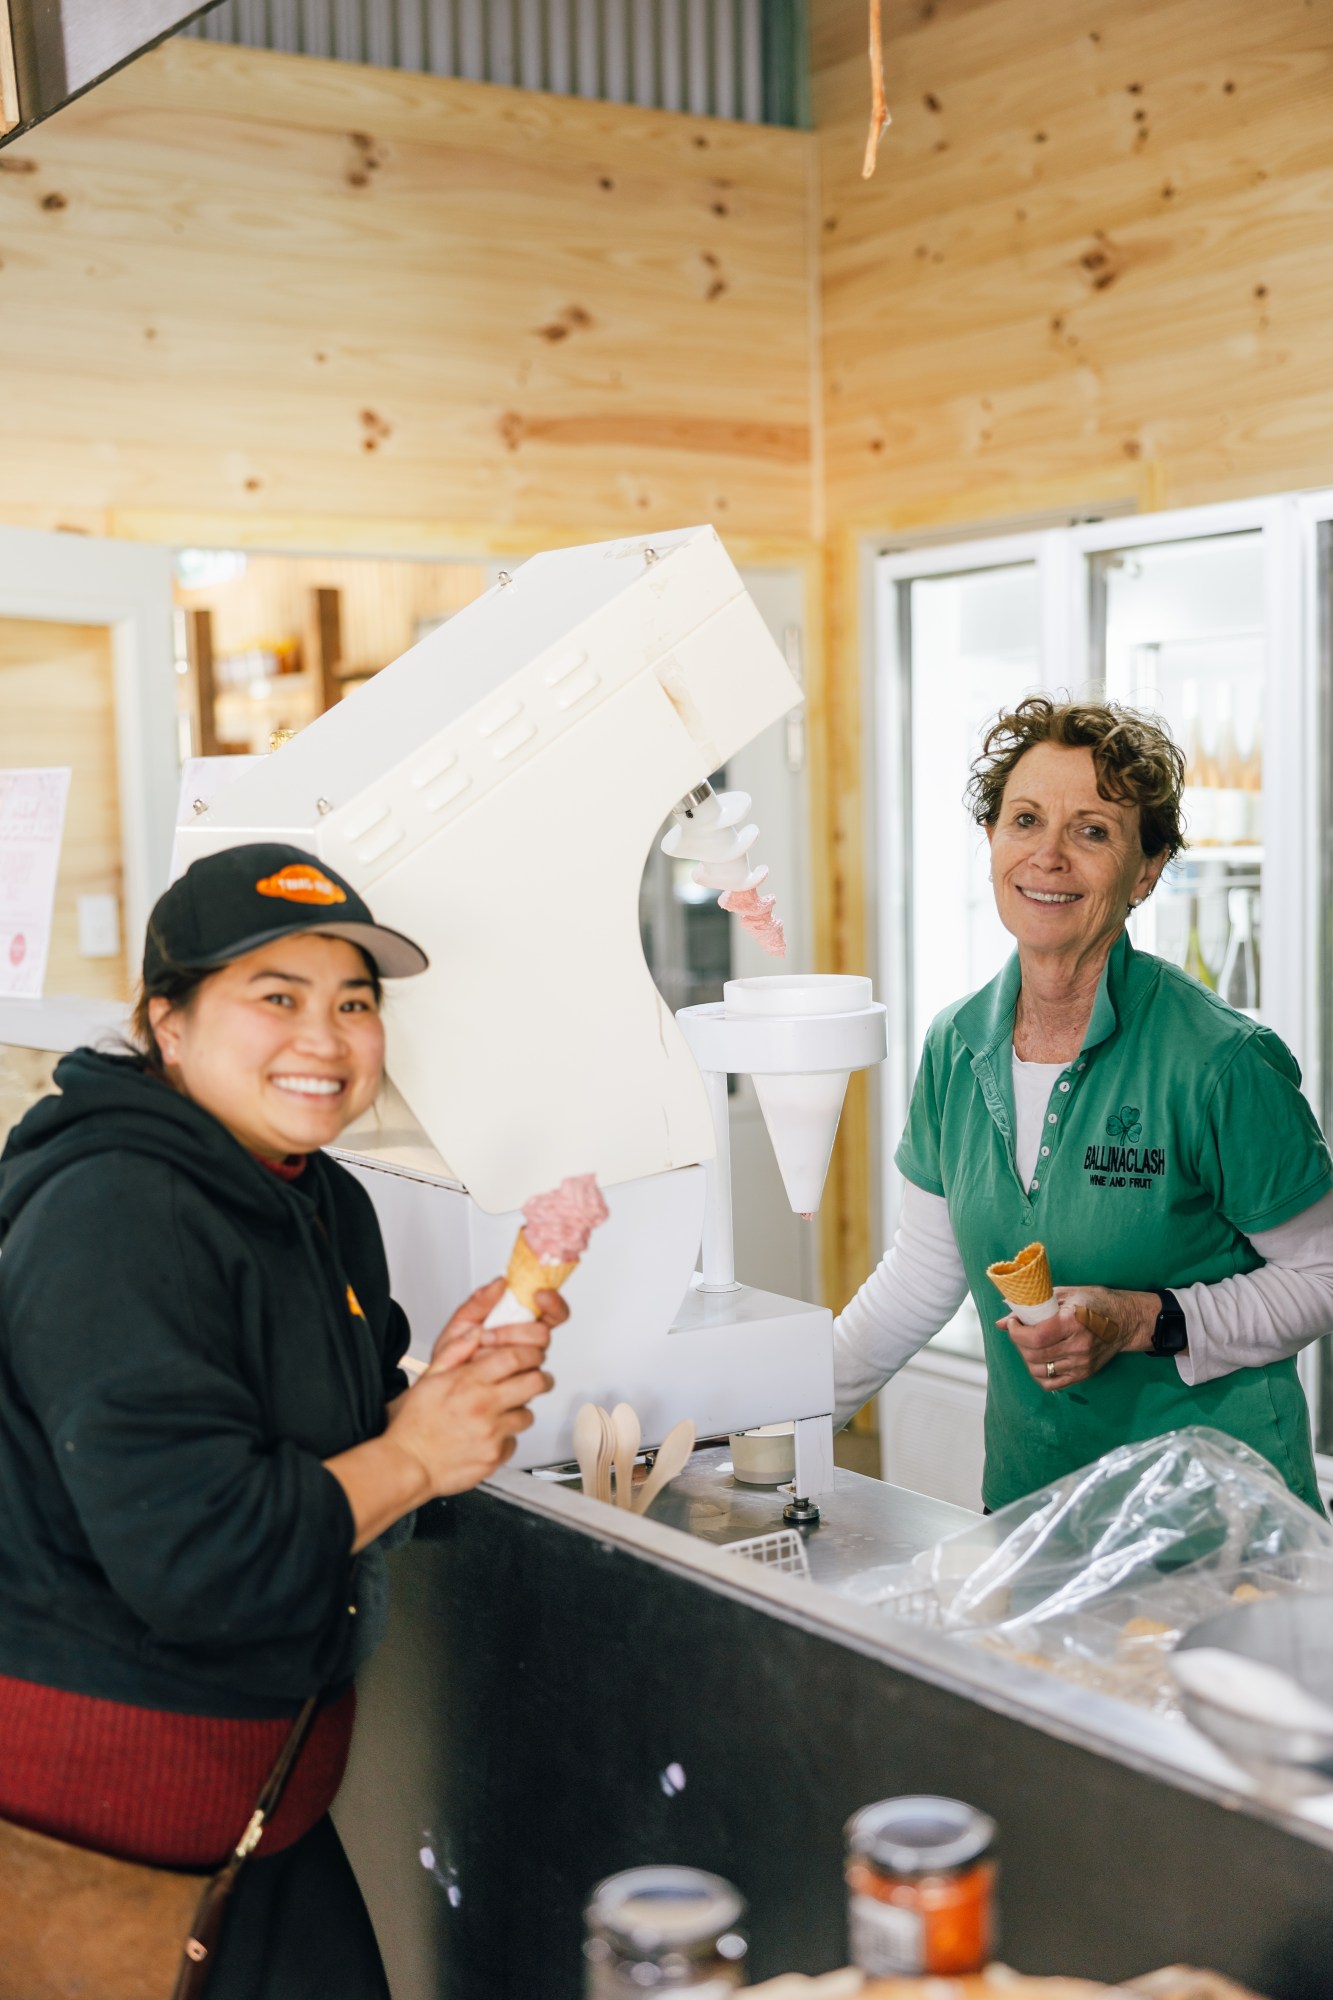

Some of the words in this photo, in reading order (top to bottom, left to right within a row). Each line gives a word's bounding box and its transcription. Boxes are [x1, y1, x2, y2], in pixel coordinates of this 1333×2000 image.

[1083, 1145, 1165, 1175] BALLINACLASH
[1090, 1174, 1107, 1186] WINE
[1109, 1176, 1126, 1187] AND
[1129, 1178, 1153, 1189] FRUIT
